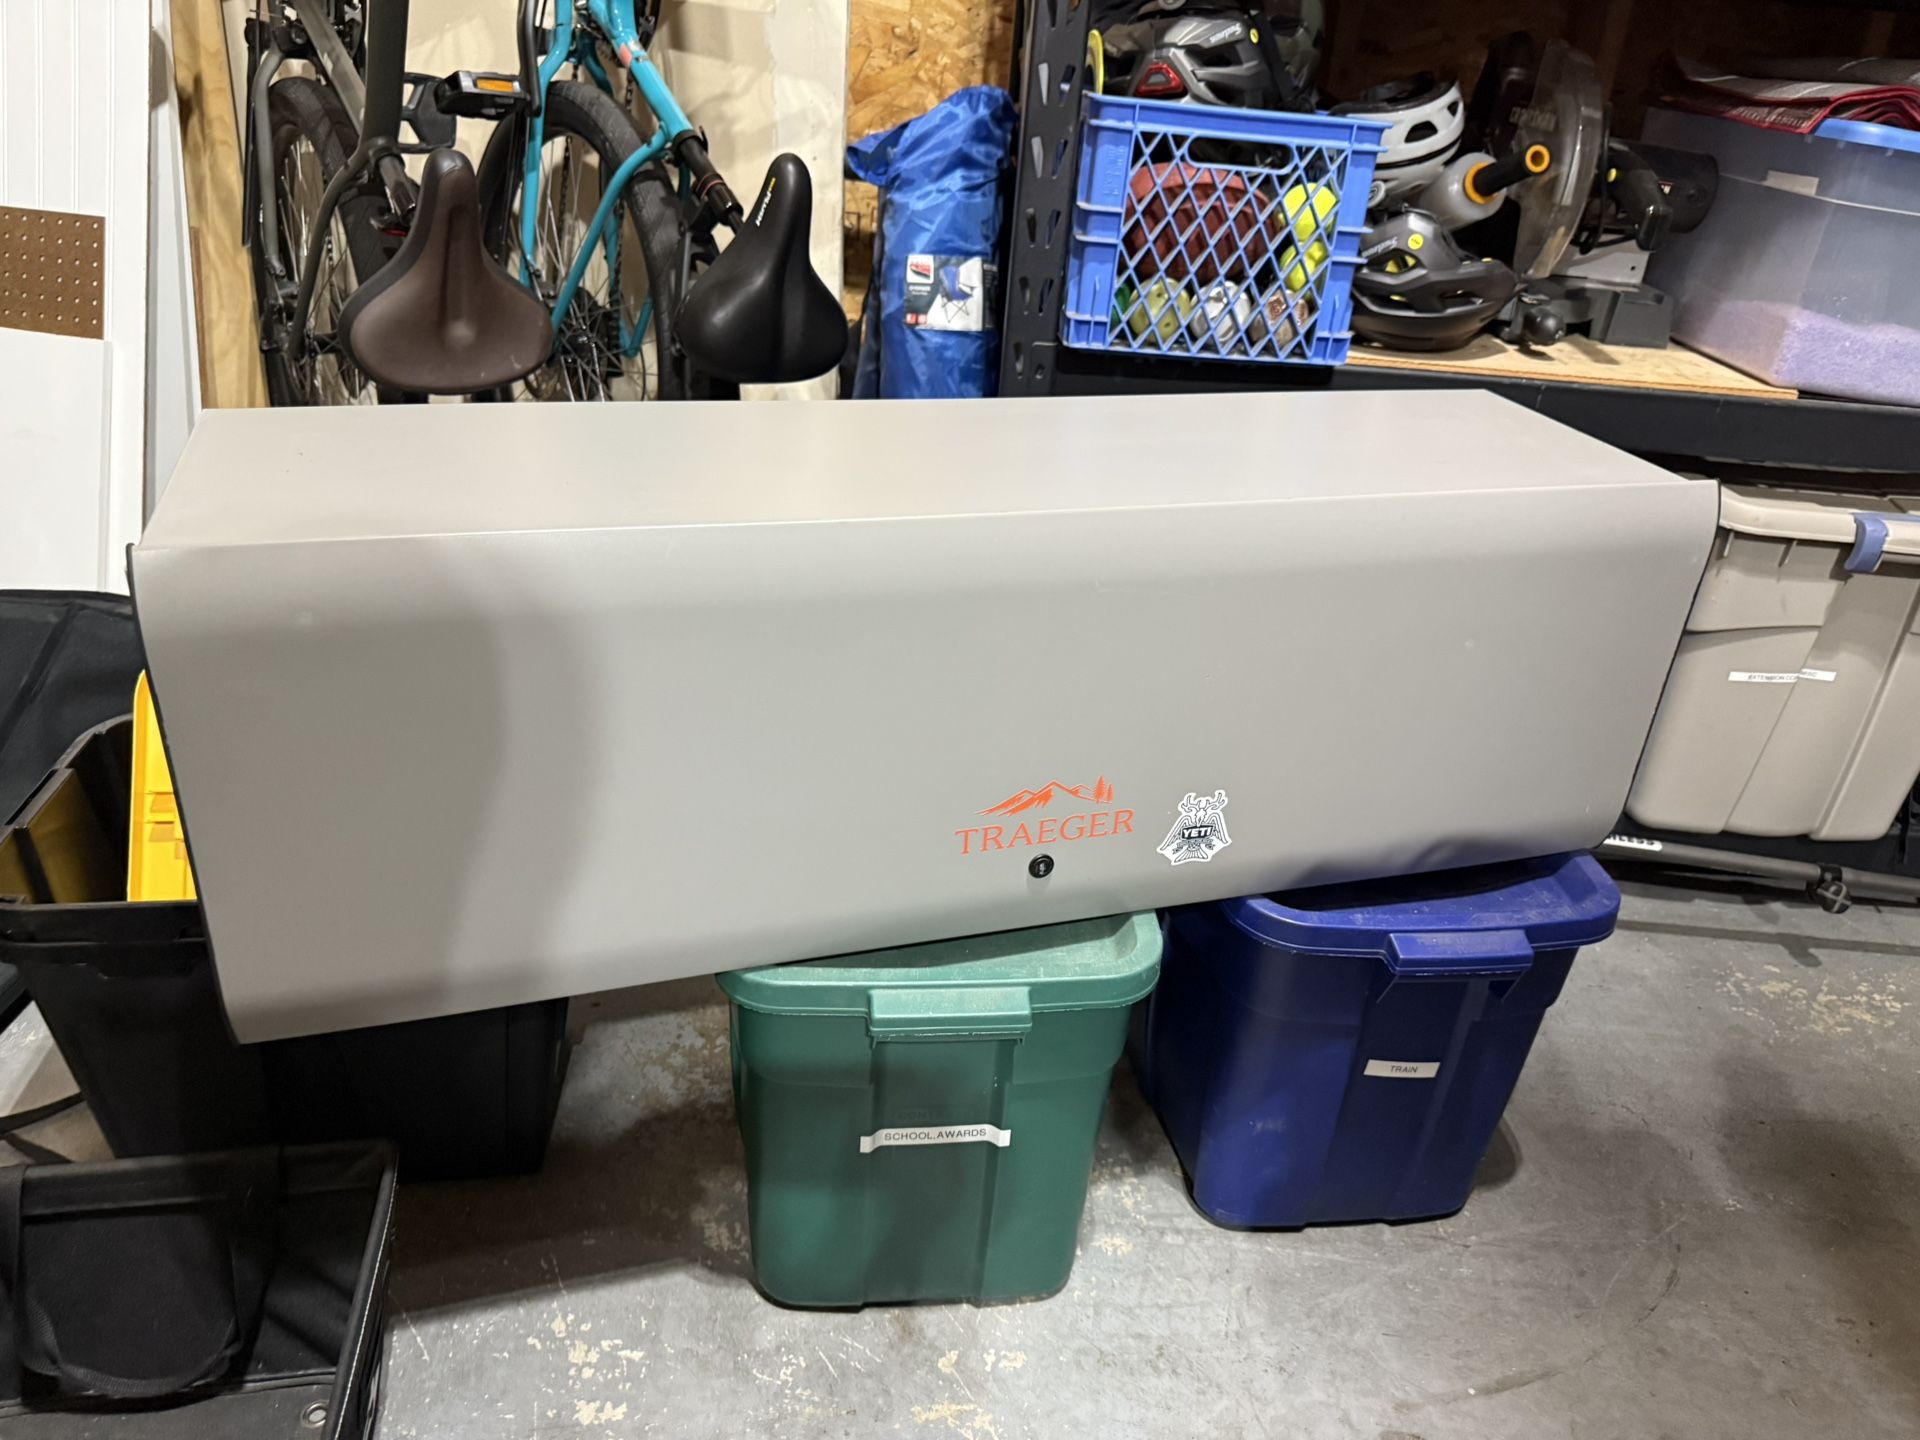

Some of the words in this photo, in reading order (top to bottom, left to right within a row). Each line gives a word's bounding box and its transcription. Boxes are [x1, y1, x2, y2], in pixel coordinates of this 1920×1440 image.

[954, 808, 1136, 856] TRAEGER
[1183, 826, 1213, 838] YETI
[1391, 1065, 1418, 1074] TRAIN
